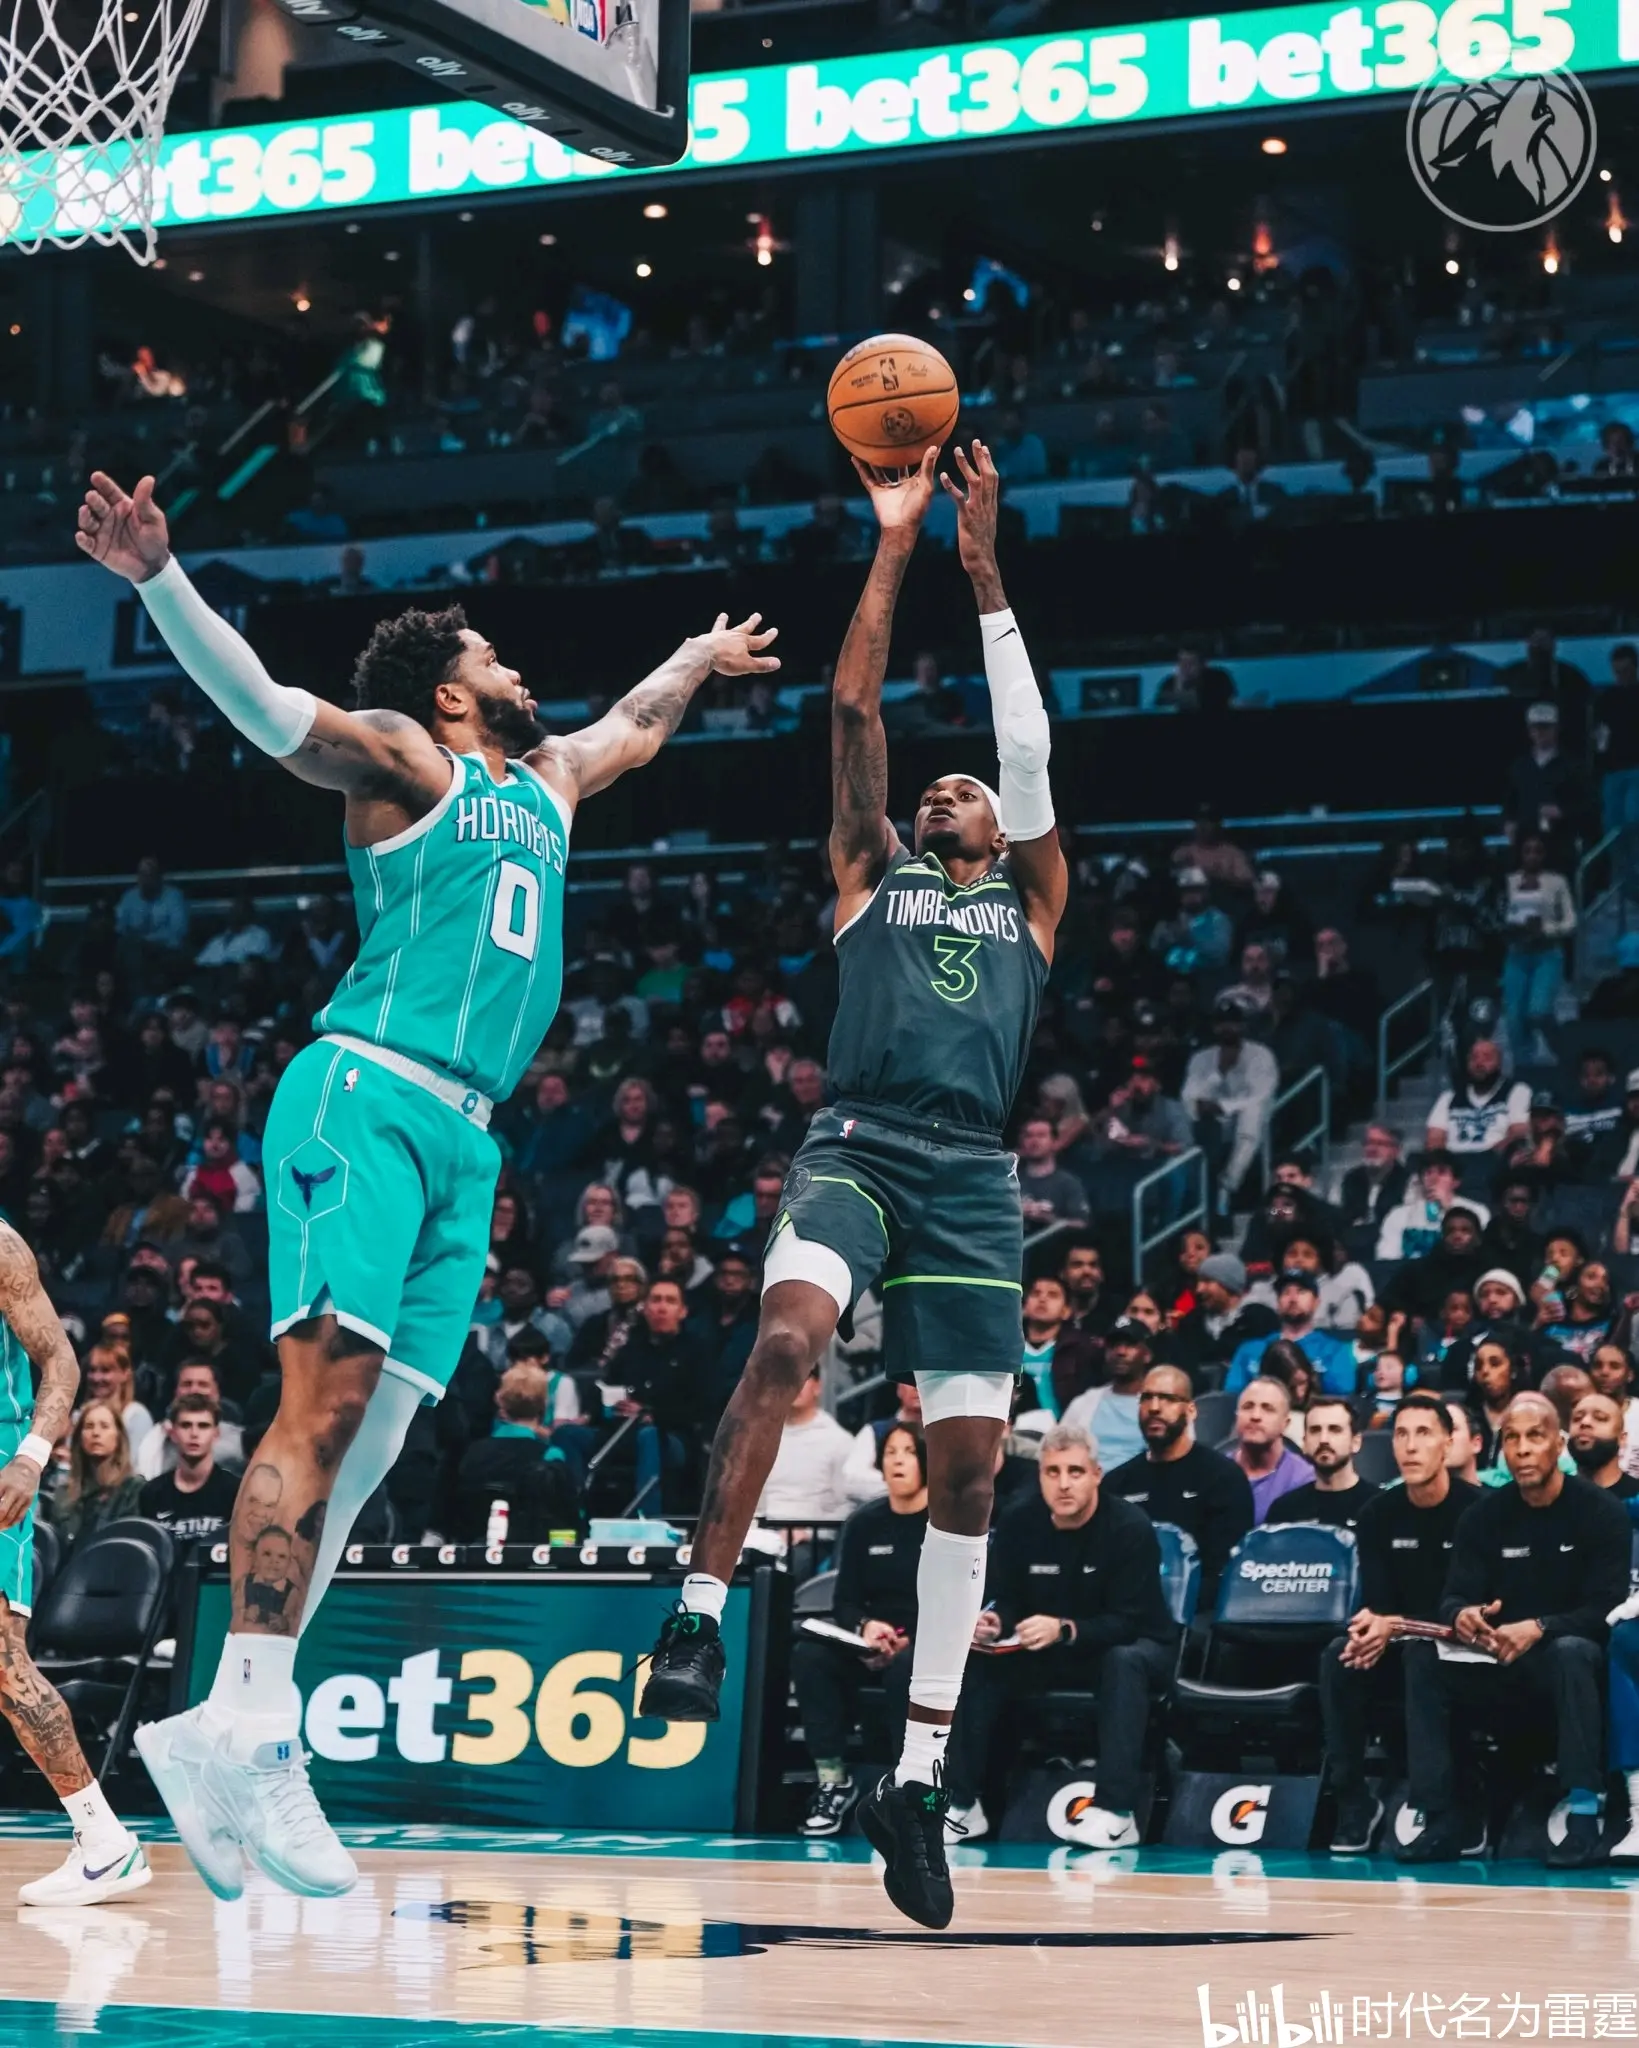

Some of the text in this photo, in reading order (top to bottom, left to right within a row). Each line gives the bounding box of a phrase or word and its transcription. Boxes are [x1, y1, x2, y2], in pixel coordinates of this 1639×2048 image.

[415, 56, 467, 76] ally
[409, 78, 750, 194] bet5
[785, 34, 1149, 153] bet365
[1189, 0, 1576, 108] bet365
[502, 101, 551, 121] ally
[590, 146, 635, 164] ally
[456, 797, 564, 877] HORNETS
[489, 860, 540, 962] 0
[931, 935, 982, 1003] 3
[1240, 1560, 1333, 1581] Spectrum
[1261, 1579, 1329, 1593] CENTER
[1211, 1785, 1273, 1845] G
